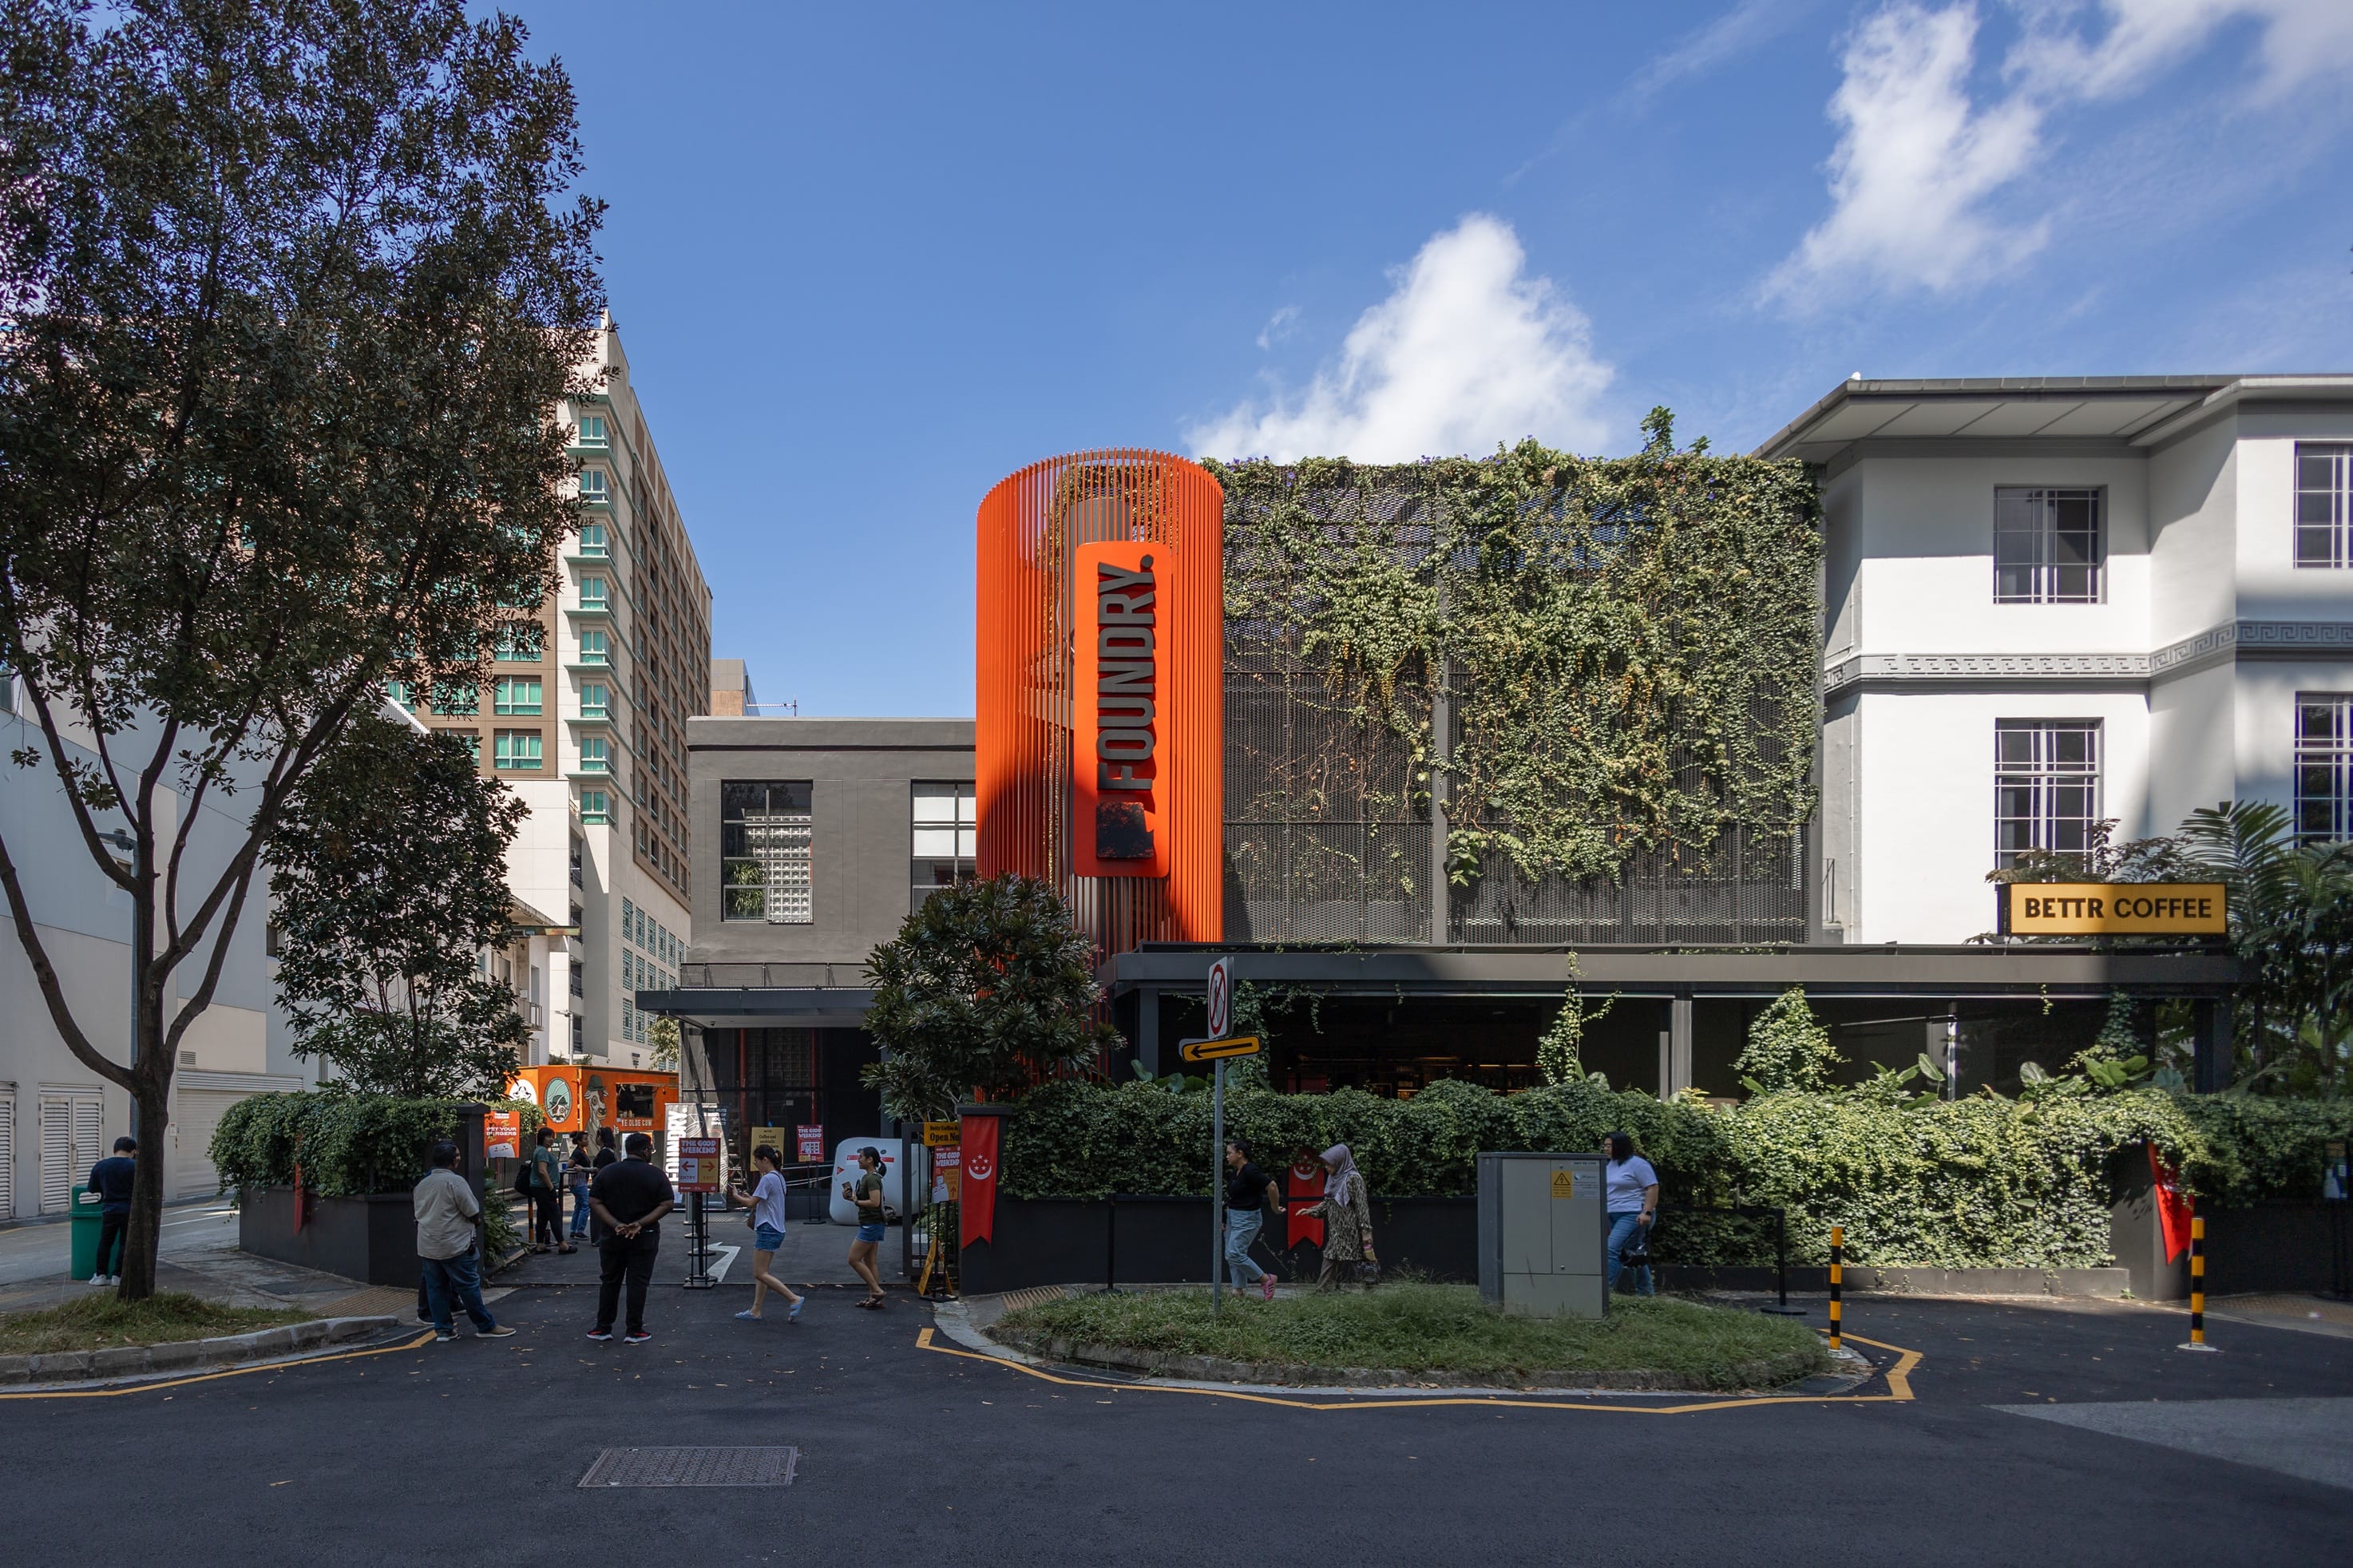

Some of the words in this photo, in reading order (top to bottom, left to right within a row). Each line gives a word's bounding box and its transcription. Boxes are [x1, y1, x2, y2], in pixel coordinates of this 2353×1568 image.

[1096, 554, 1155, 789] FOUNDRY.
[2024, 898, 2104, 918] BETTR
[2113, 898, 2212, 918] COFFEE
[930, 1133, 949, 1142] Open
[950, 1132, 960, 1141] No
[936, 1158, 960, 1167] WEEKEND
